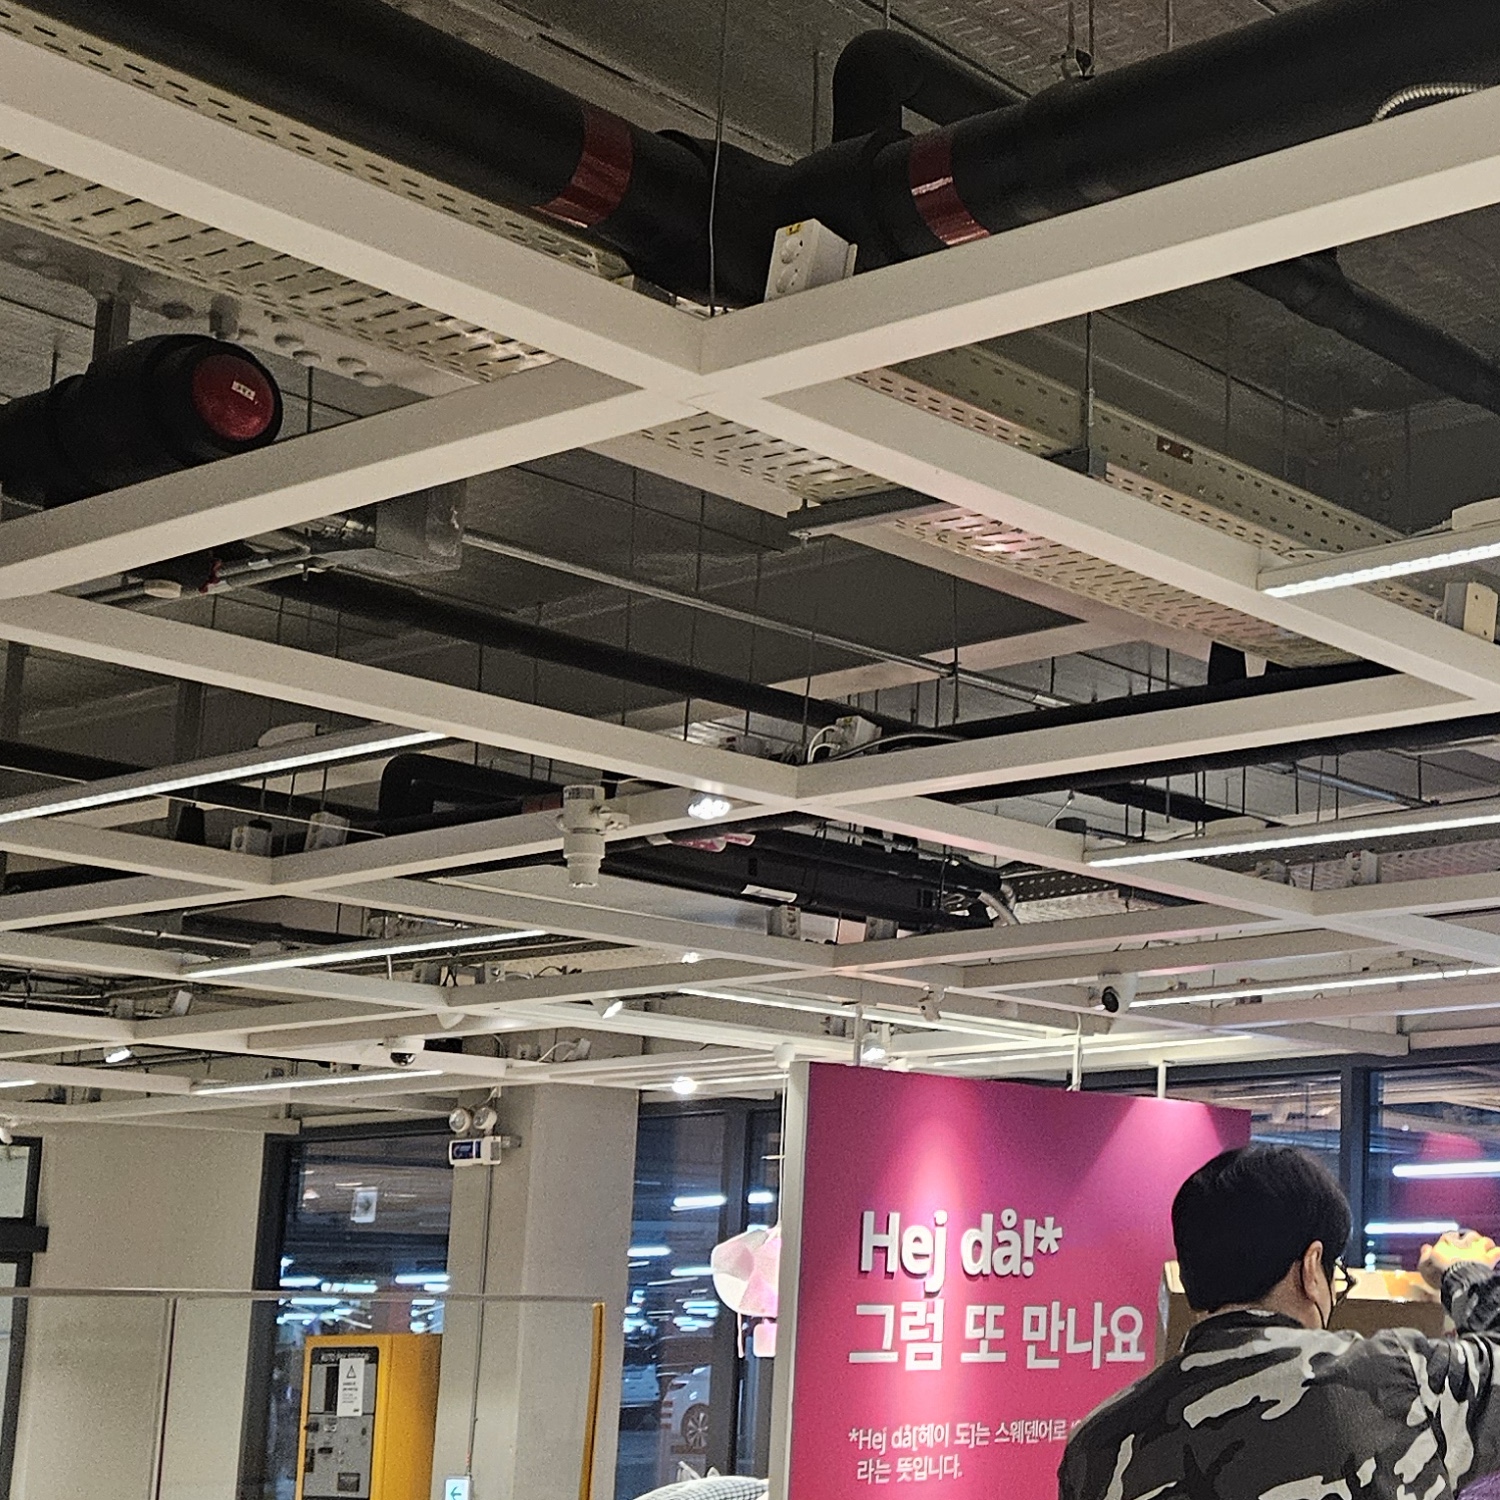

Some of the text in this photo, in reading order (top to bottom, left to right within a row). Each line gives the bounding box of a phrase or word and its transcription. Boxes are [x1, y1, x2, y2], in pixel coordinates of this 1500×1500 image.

[860, 1210, 948, 1293] Hej
[849, 1299, 1146, 1371] 그럼 또 만나요
[994, 1418, 1067, 1445] 스웨덴어로
[857, 1454, 963, 1484] 라는 뜻입니다.
